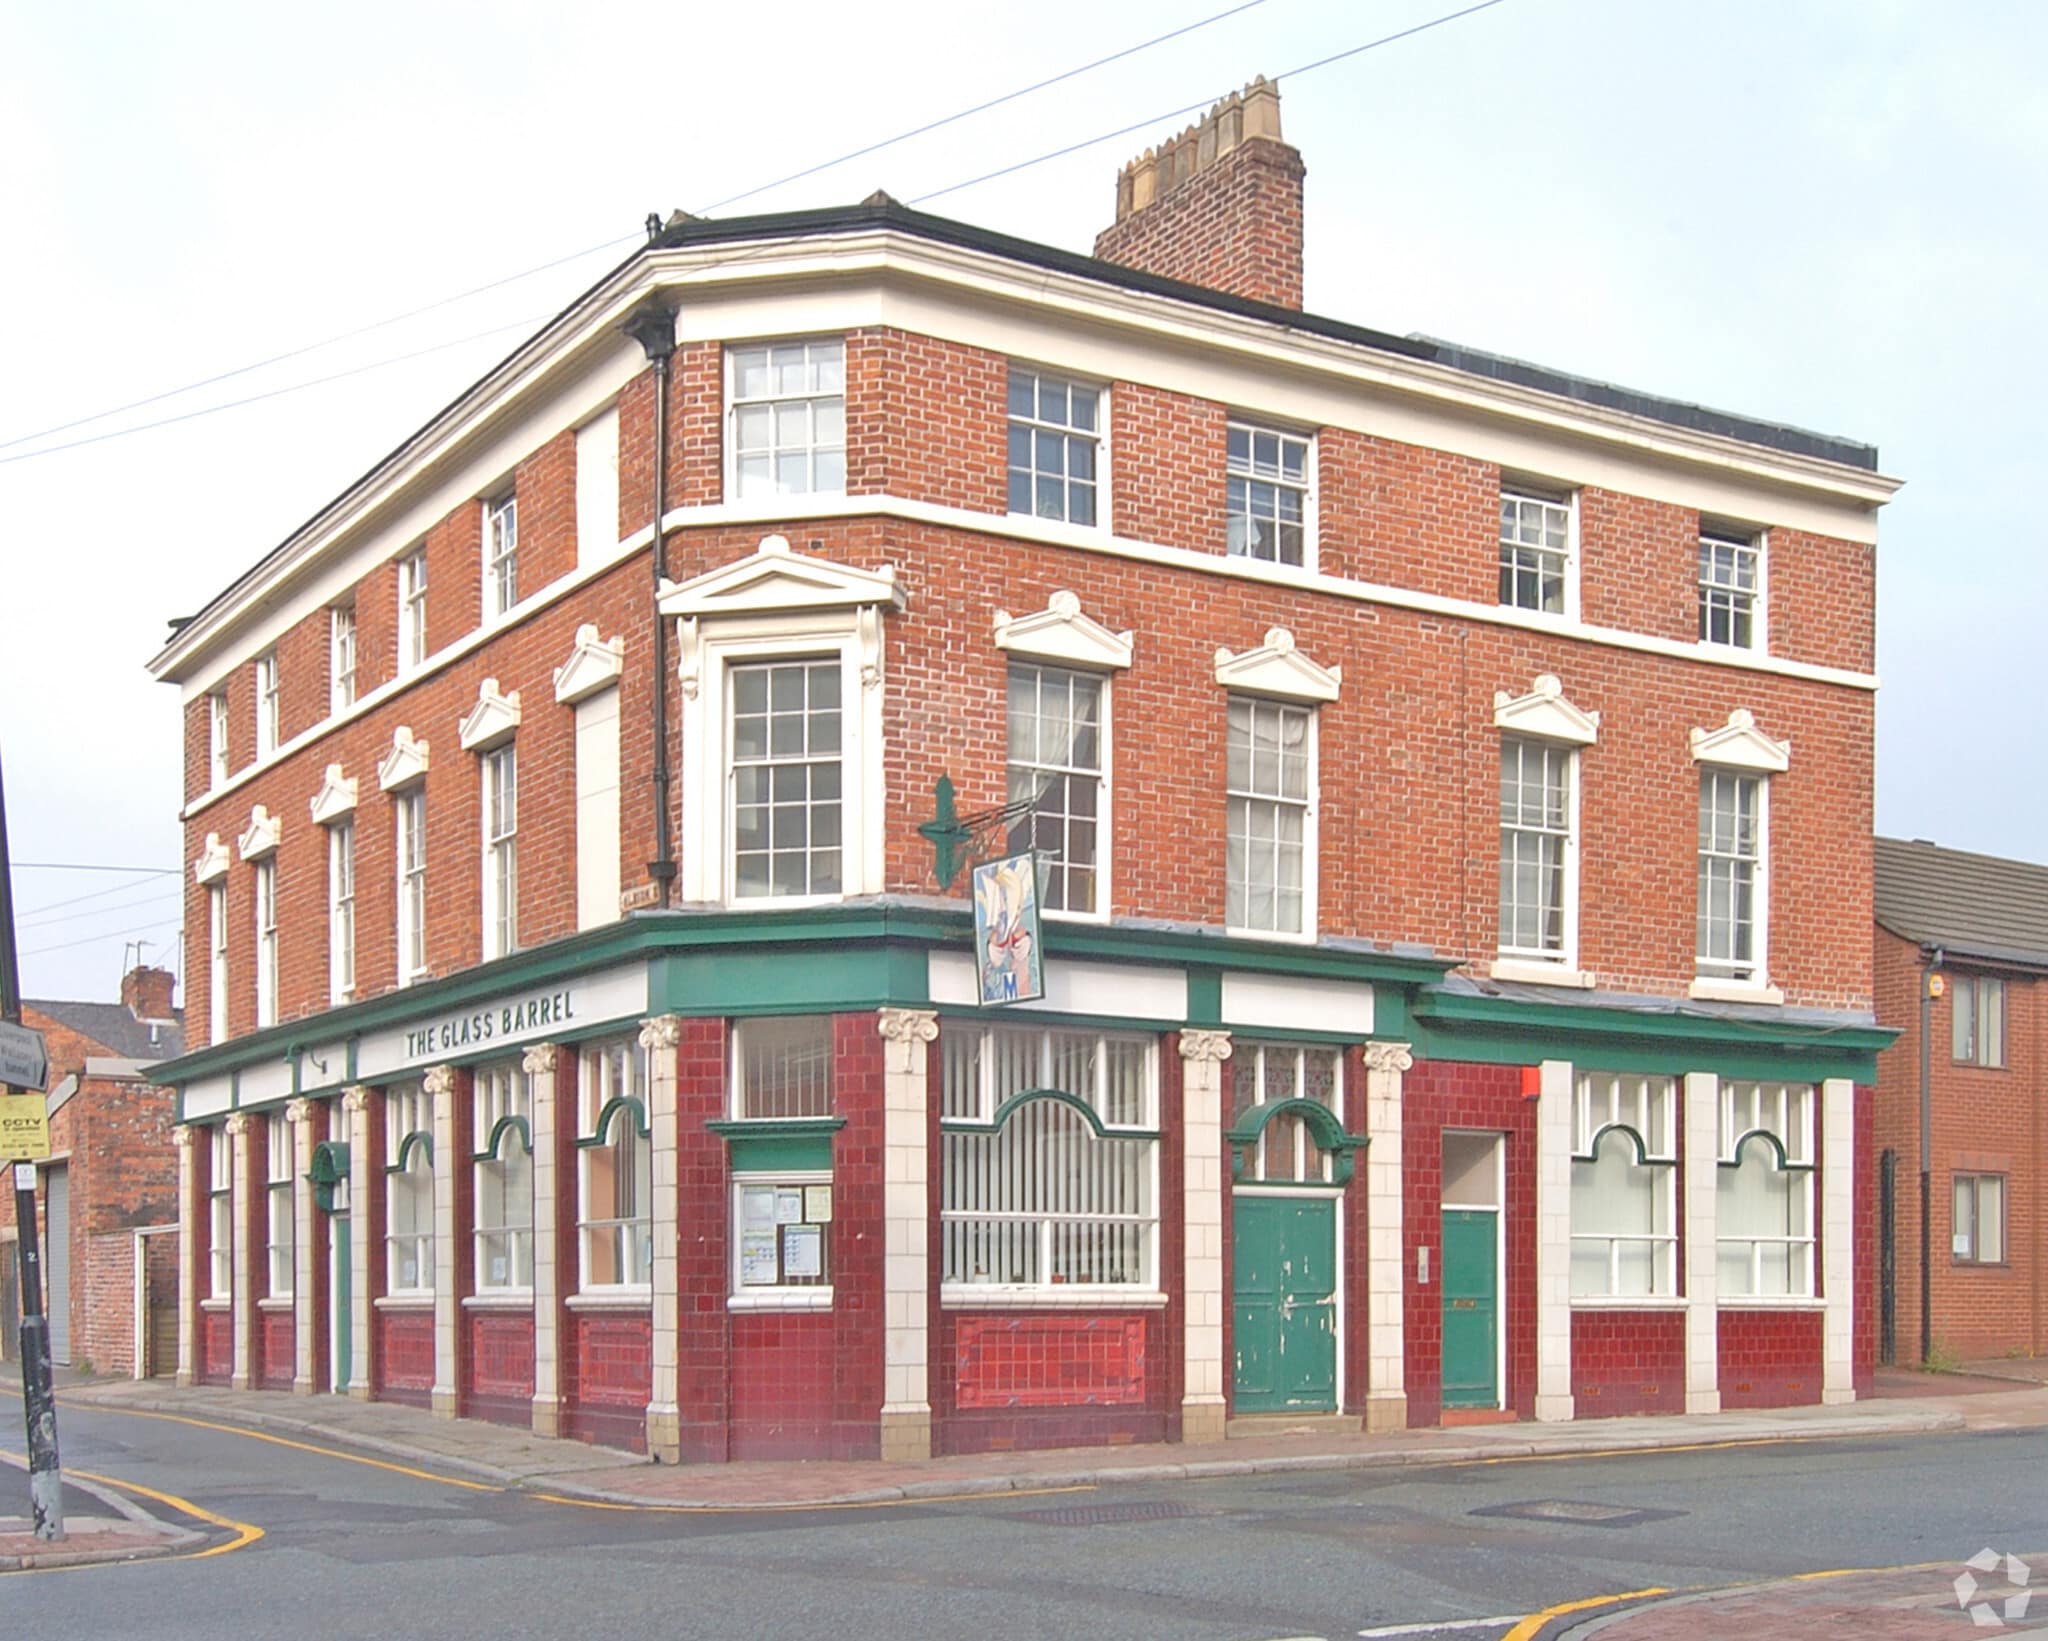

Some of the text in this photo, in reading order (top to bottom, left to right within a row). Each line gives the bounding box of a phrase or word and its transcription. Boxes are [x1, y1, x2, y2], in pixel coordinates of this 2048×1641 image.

[407, 991, 573, 1057] THE GLASS BARREL
[3, 1118, 41, 1127] CCTV
